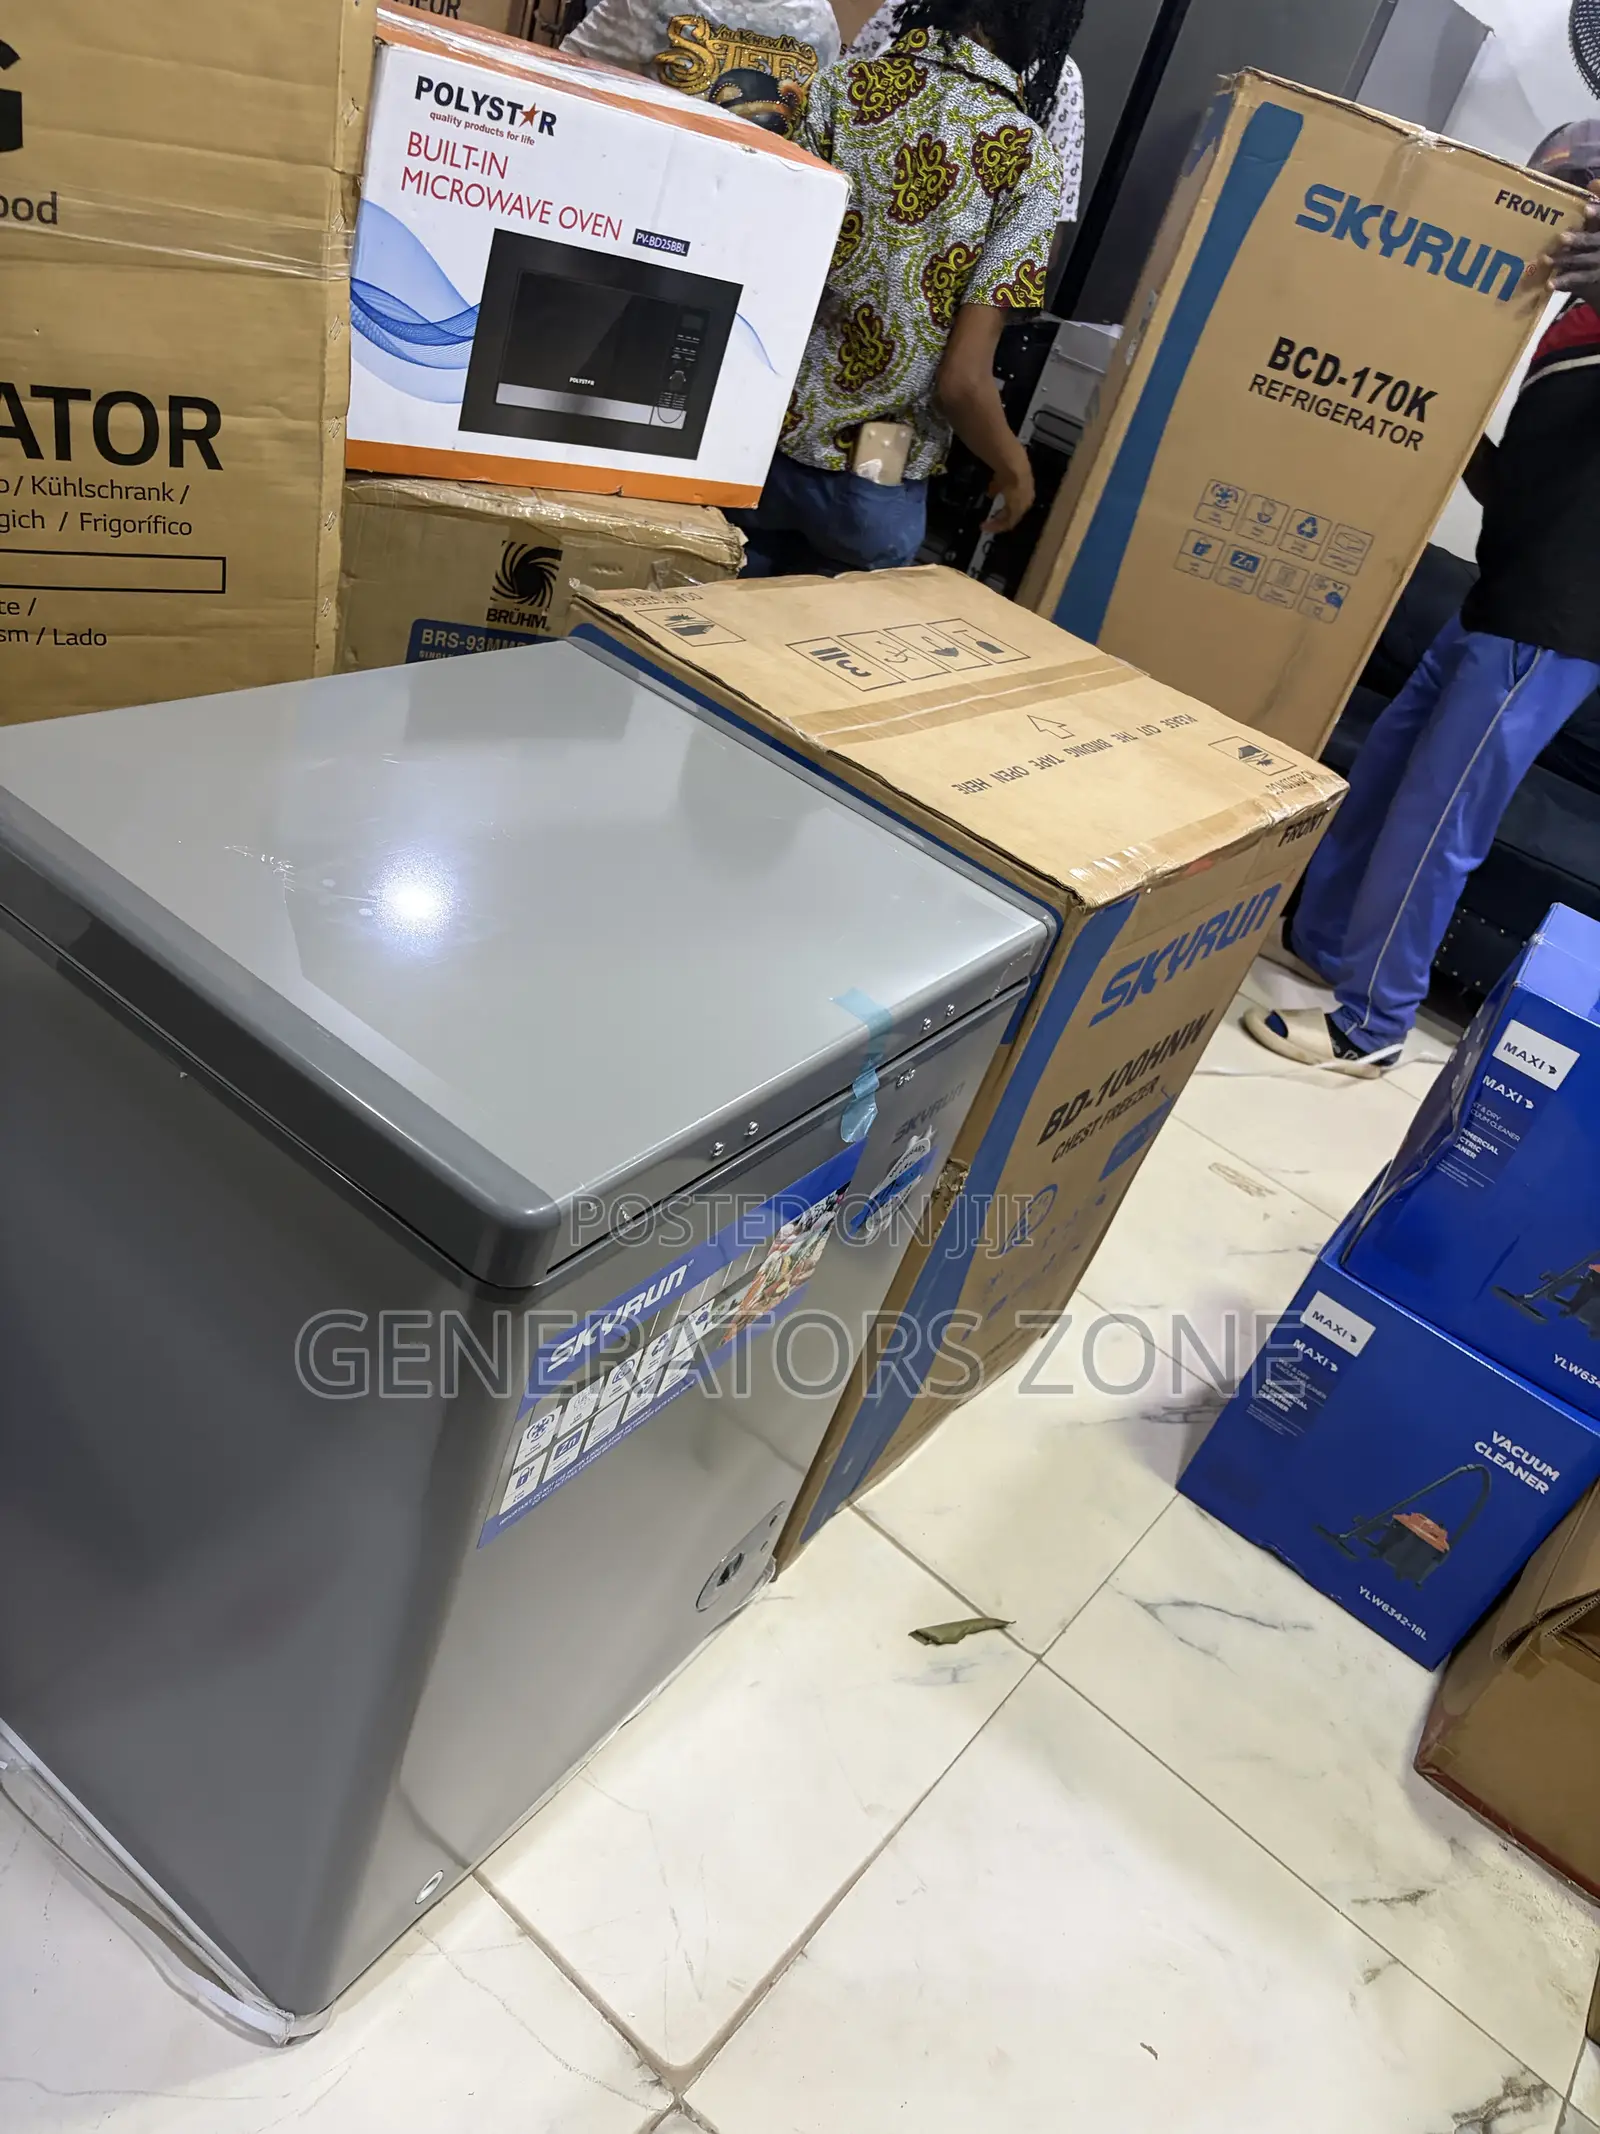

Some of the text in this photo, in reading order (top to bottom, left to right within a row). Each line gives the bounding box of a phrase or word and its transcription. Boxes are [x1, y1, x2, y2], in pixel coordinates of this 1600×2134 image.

[429, 111, 535, 146] quality products for life
[407, 131, 509, 180] BUILT-IN
[0, 191, 58, 225] od
[401, 167, 623, 241] MICROWAVE OVEN
[1495, 189, 1565, 226] FRONT
[635, 232, 686, 254] PV-BD25BBL
[1295, 184, 1525, 302] SKYRUN
[1267, 336, 1438, 423] BCD-170K
[1248, 373, 1424, 451] REFRIGERATOR
[32, 475, 175, 503] Kühlschrank
[79, 511, 193, 539] Frigorífico
[486, 608, 547, 629] BRÜHM
[53, 627, 108, 647] Lado
[1111, 731, 1139, 744] THE
[1139, 724, 1162, 737] CUT
[1028, 753, 1065, 770] TAPE
[1063, 738, 1113, 758] BINDING
[951, 777, 992, 795] HERE
[989, 765, 1030, 784] OPEN
[1088, 883, 1283, 1028] SKYRUN
[1503, 1041, 1546, 1071] MAXI
[1037, 1009, 1215, 1147] BD-100HNW
[1482, 1075, 1523, 1104] MAXI
[1051, 1114, 1103, 1164] CHEST
[1098, 1075, 1161, 1130] FREEZER
[547, 1264, 687, 1373] SKYRUN
[1311, 1311, 1348, 1338] MAXI
[1292, 1339, 1329, 1367] MAXI
[1474, 1441, 1549, 1495] CLEANER
[1491, 1430, 1560, 1482] VACUUM
[1358, 1585, 1428, 1642] YLW6342-18L
